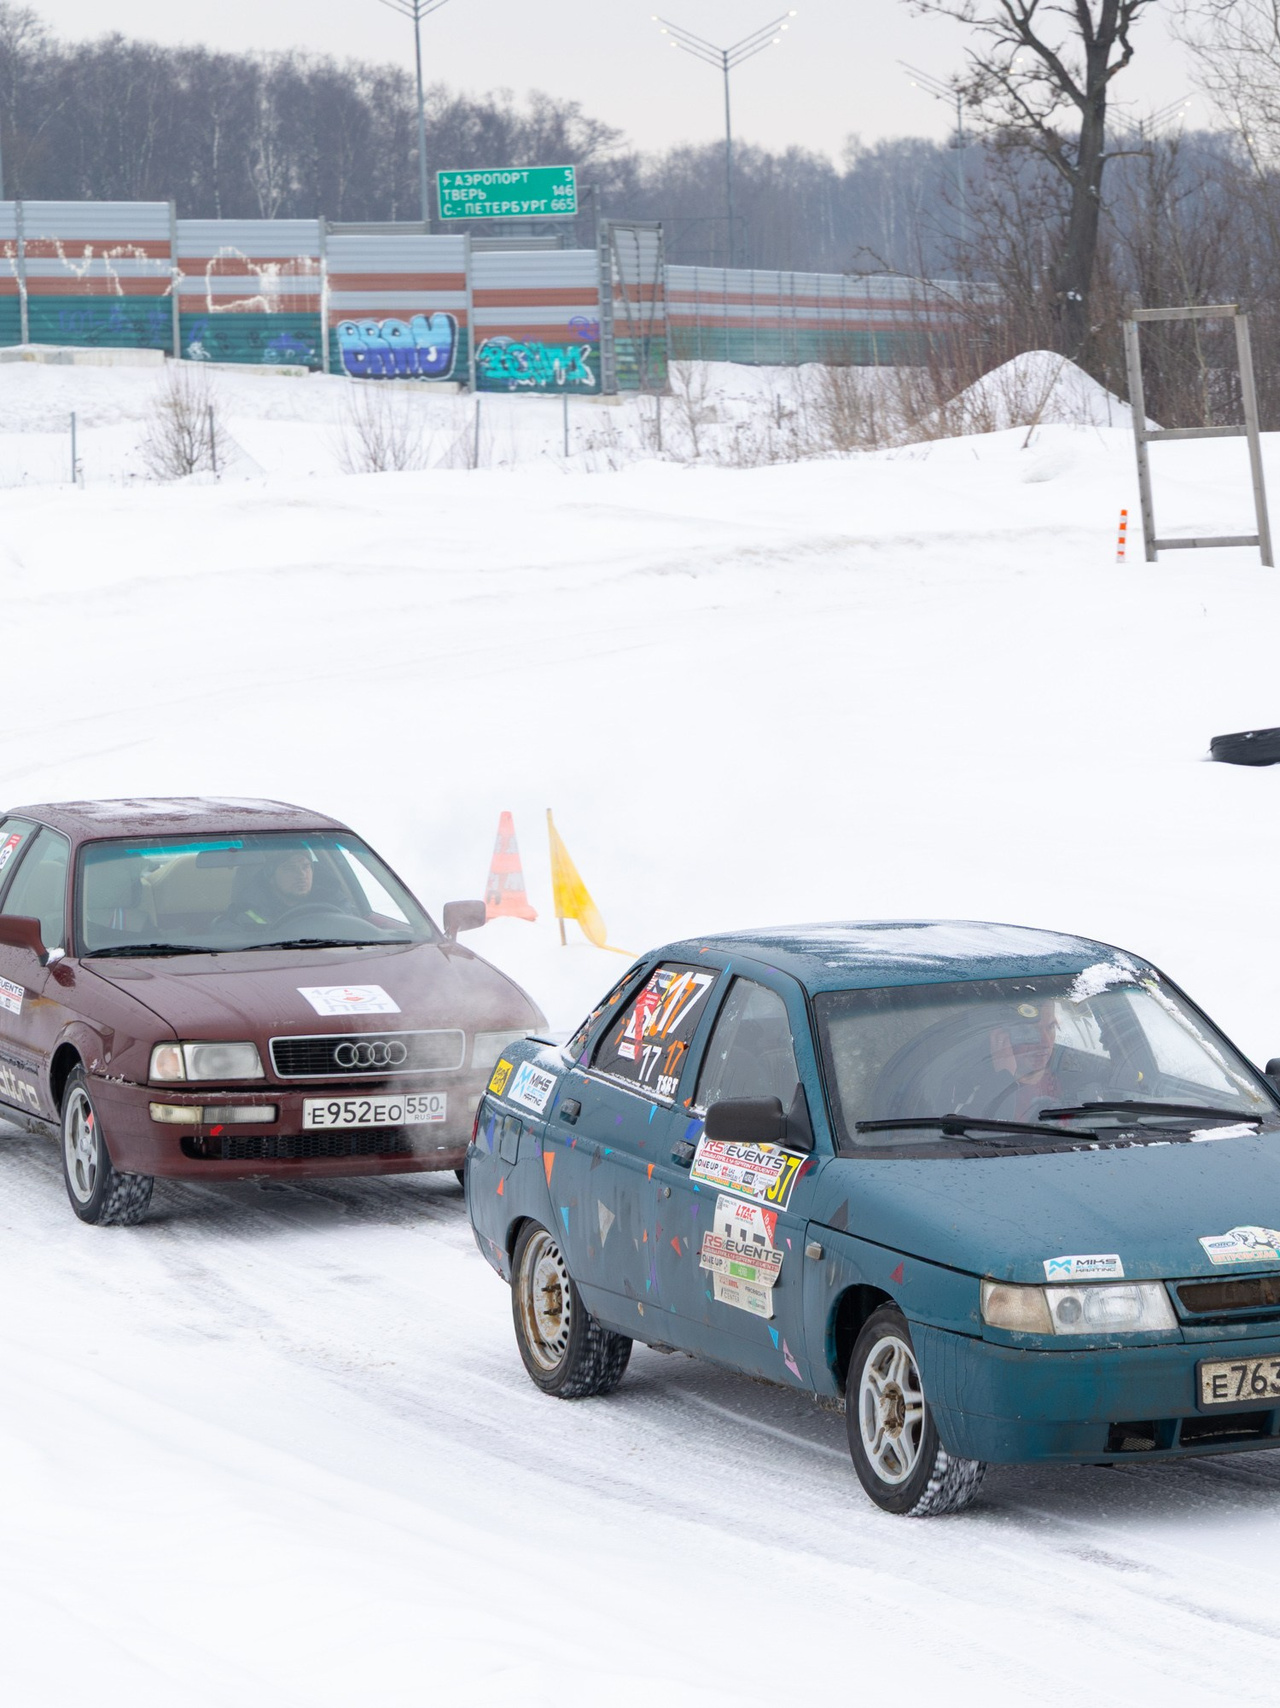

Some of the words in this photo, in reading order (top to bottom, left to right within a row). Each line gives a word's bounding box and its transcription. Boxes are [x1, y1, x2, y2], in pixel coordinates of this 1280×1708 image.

[455, 172, 529, 187] АЭРОПОРТ
[564, 170, 573, 182] 5
[443, 188, 486, 201] ТВЕРЬ
[552, 184, 574, 197] 146
[465, 200, 548, 215] ПЕТЕРБУРГ
[550, 198, 575, 211] 665
[0, 980, 24, 997] VENTS
[638, 1043, 662, 1082] 17
[667, 1040, 685, 1077] 17
[529, 1073, 552, 1092] MIKS
[312, 1101, 403, 1125] Е952ЕО
[406, 1096, 435, 1114] 550
[705, 1140, 725, 1153] RS
[726, 1145, 786, 1170] EVENTS
[704, 1234, 723, 1248] RS
[725, 1240, 783, 1265] EVENTS
[1075, 1258, 1118, 1266] MIKS
